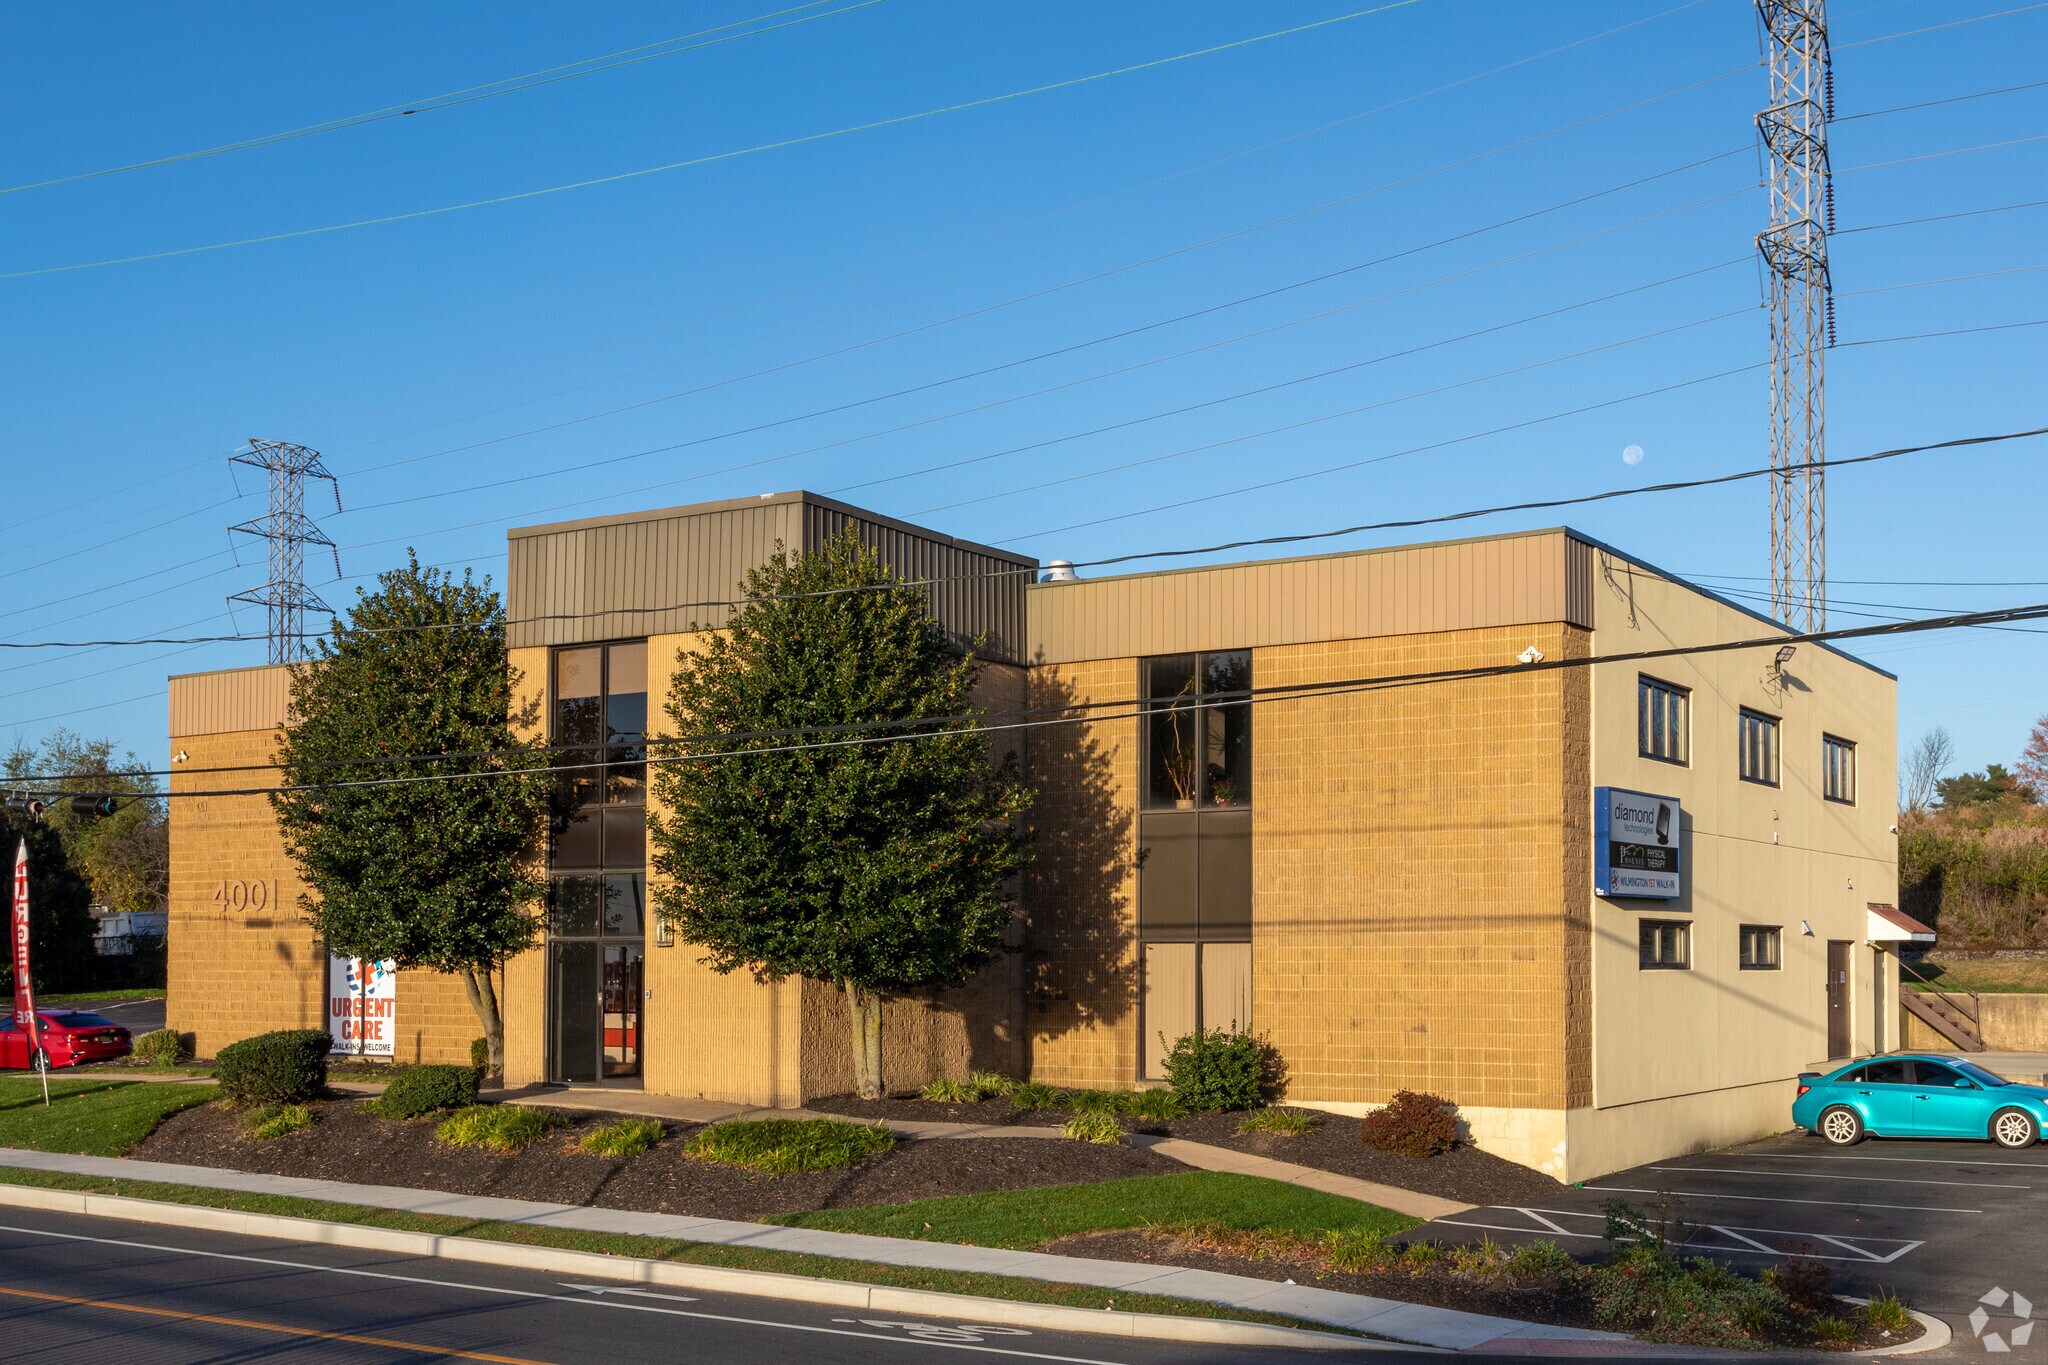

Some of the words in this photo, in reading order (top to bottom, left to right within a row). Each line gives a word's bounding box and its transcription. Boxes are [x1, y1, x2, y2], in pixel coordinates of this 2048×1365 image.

[1615, 803, 1654, 823] diamond
[1624, 824, 1653, 836] technologies
[1647, 859, 1666, 869] THERAPY
[1620, 877, 1648, 888] WILMINGTON
[1657, 879, 1675, 889] WALK-IN
[212, 879, 278, 912] 4001
[332, 998, 394, 1017] URGENT
[342, 1020, 383, 1040] CARE
